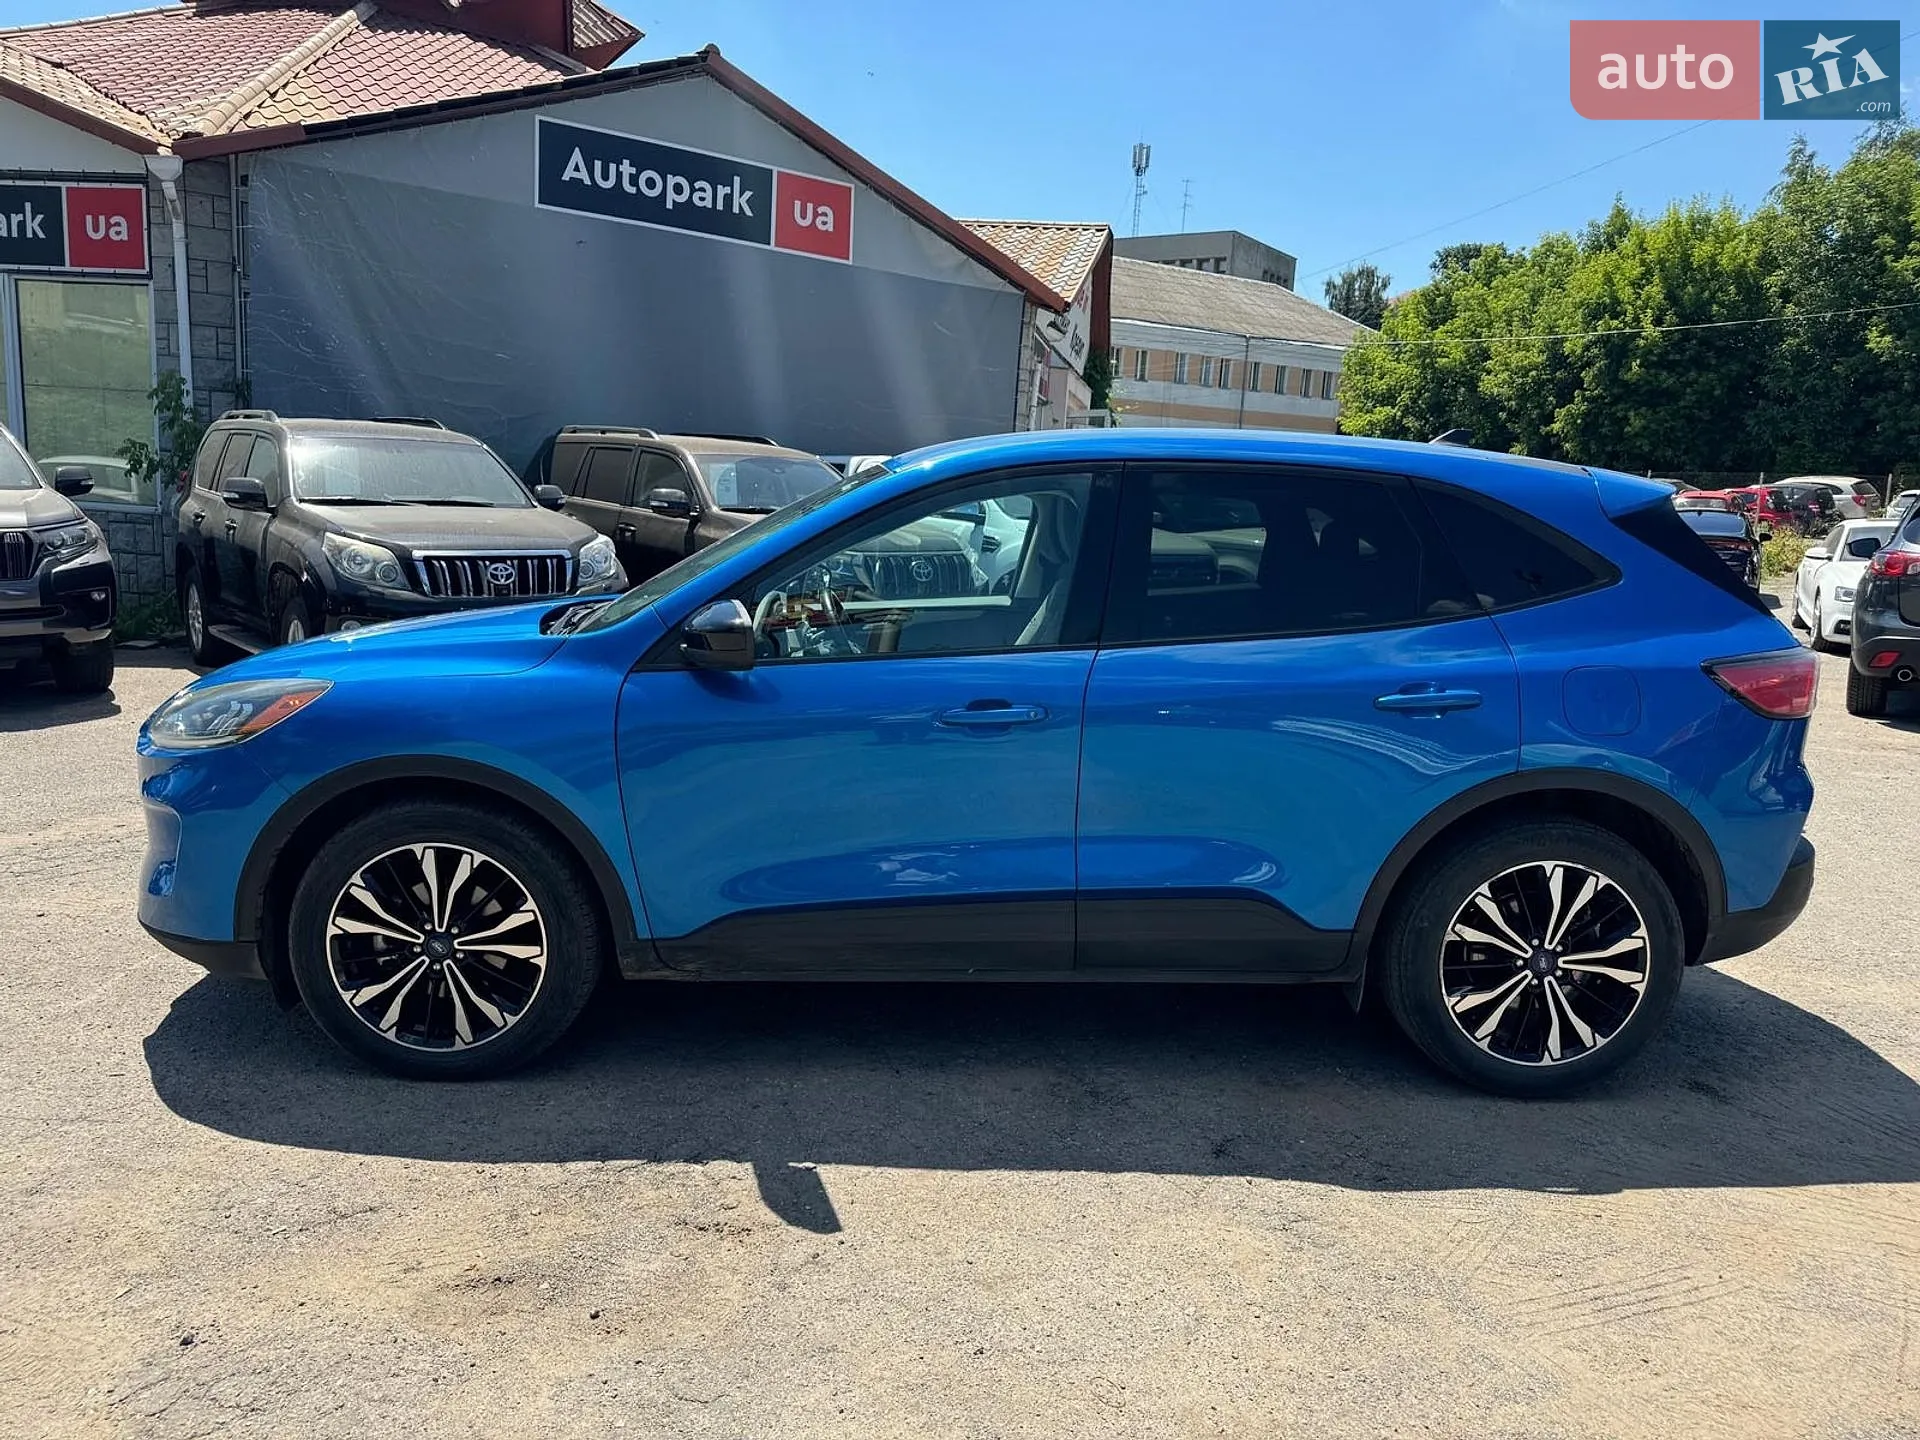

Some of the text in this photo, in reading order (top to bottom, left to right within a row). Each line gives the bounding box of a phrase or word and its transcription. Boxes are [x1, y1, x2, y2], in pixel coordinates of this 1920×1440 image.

[561, 146, 834, 232] Autopark ua
[85, 214, 129, 241] ua
